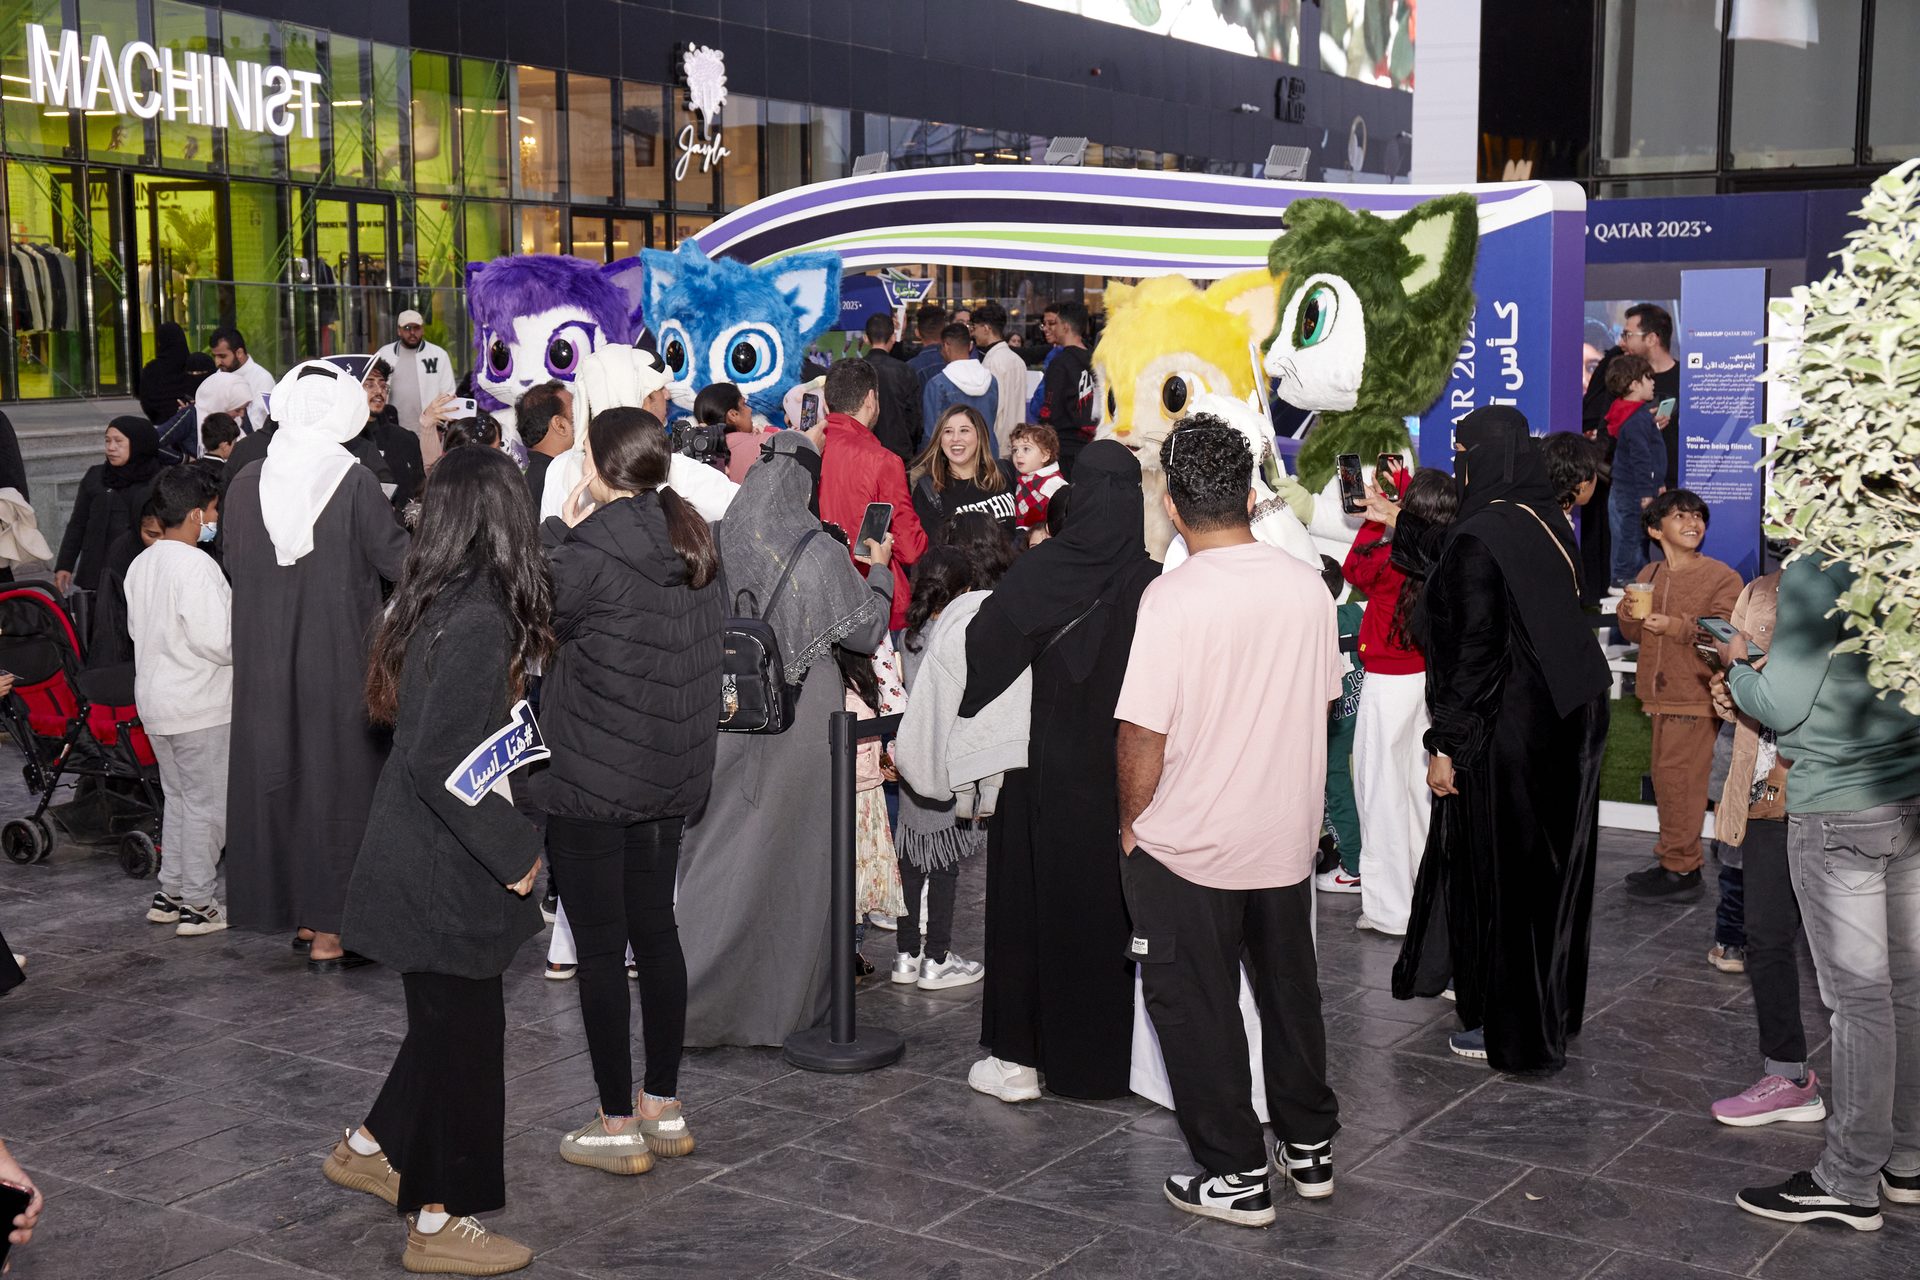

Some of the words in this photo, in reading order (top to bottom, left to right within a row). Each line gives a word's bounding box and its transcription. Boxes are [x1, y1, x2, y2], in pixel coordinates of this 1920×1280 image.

[25, 22, 322, 139] MACHINIST
[675, 125, 731, 182] Jayla
[1594, 223, 1653, 243] QATAR
[422, 358, 438, 374] W
